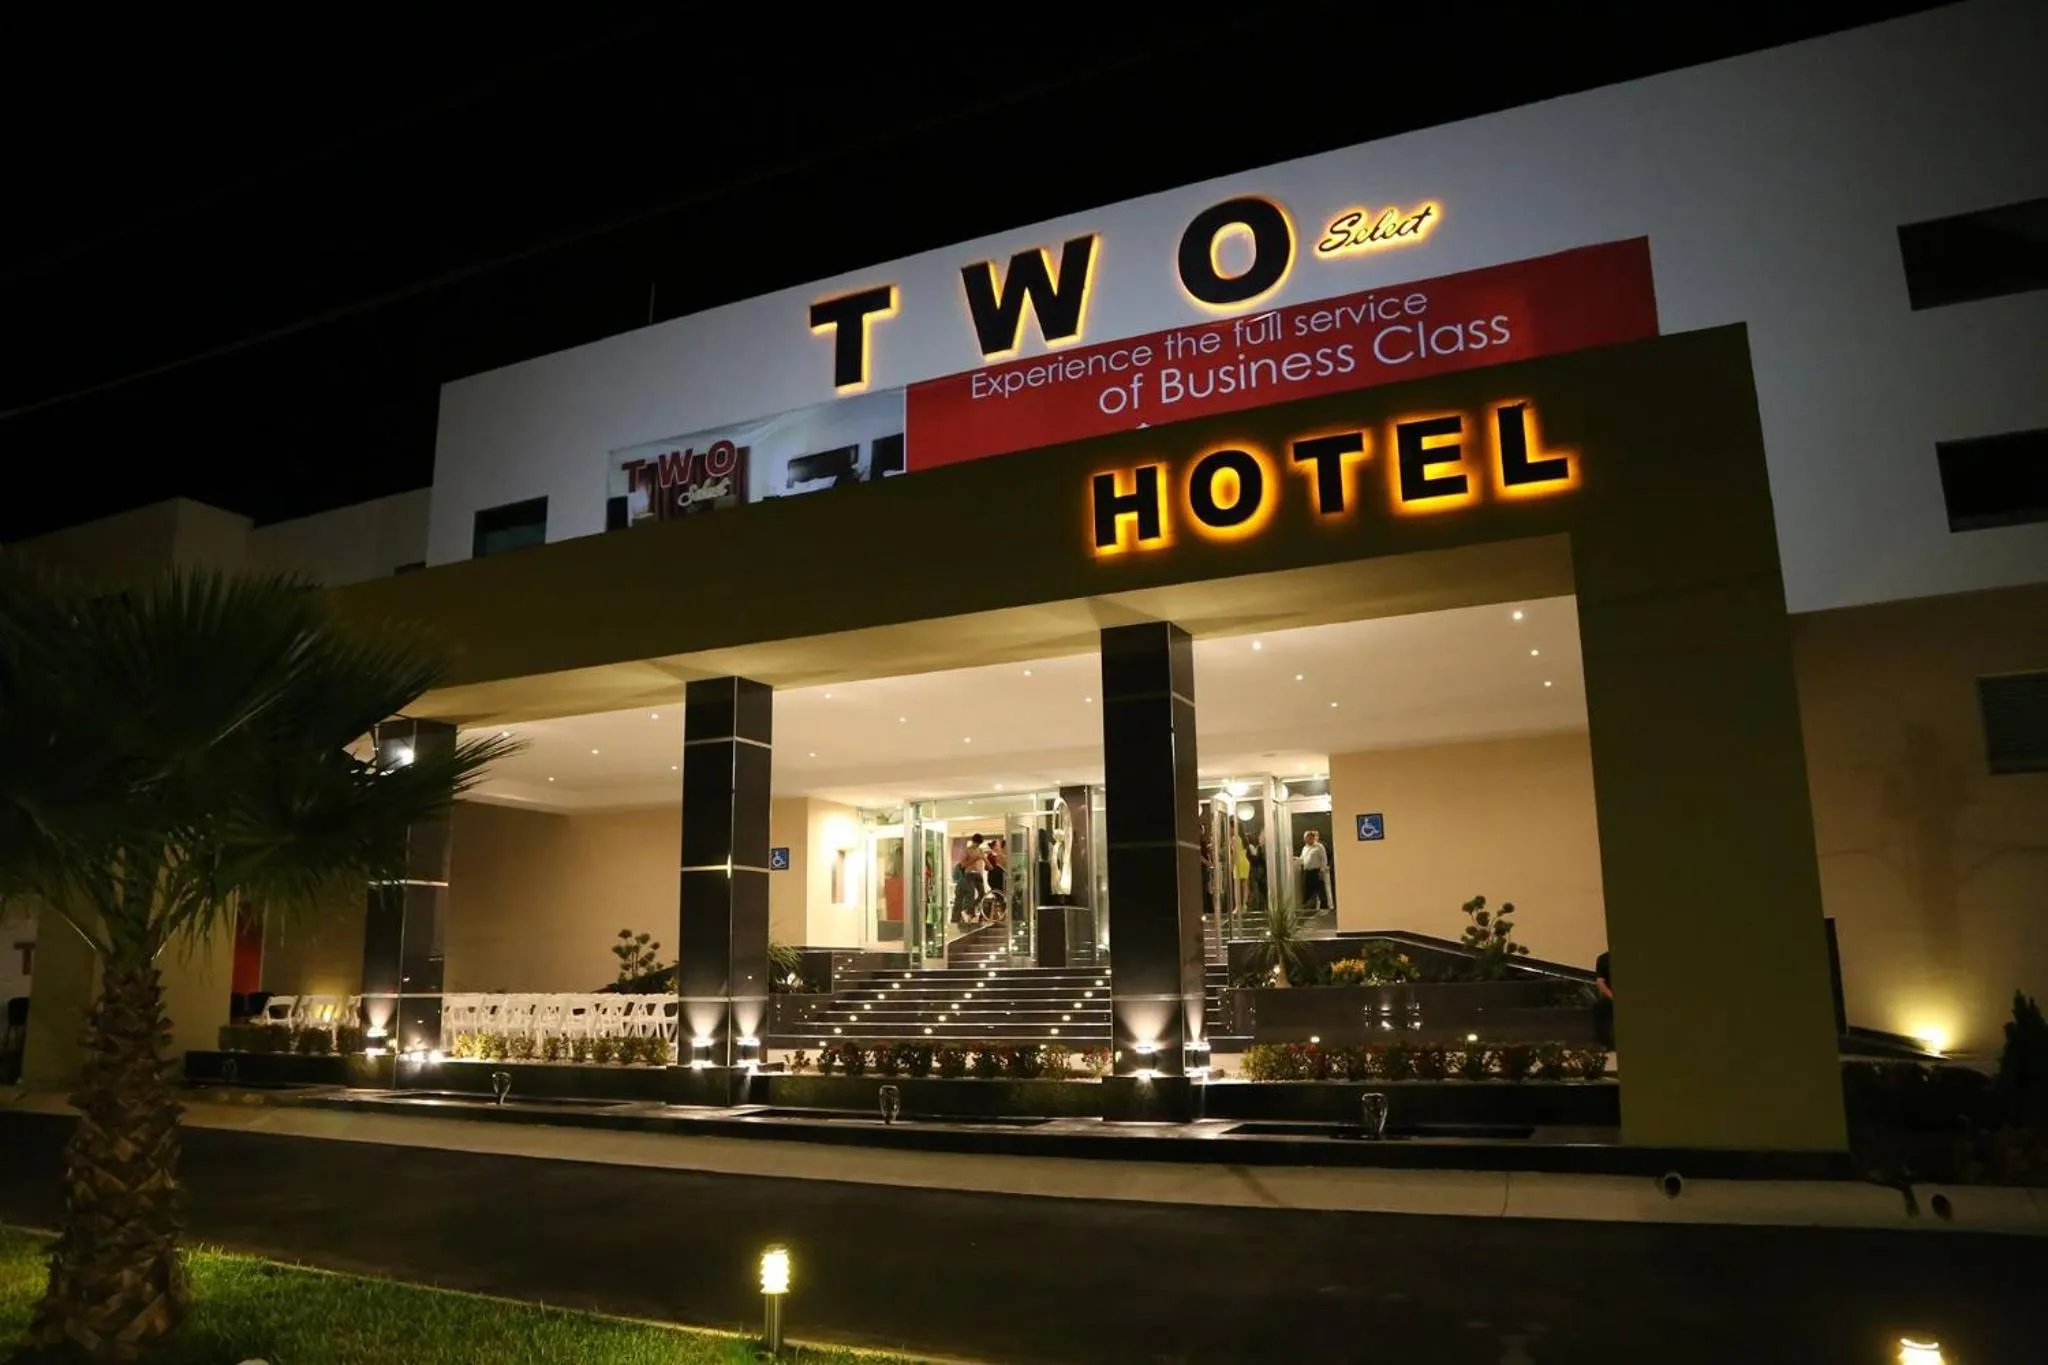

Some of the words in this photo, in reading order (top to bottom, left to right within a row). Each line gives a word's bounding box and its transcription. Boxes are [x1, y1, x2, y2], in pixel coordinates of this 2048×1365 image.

[810, 197, 1292, 389] TWO
[1318, 205, 1432, 252] Select
[971, 345, 1153, 399] Experience
[1164, 331, 1221, 361] the
[1233, 311, 1282, 347] full
[1294, 293, 1428, 337] service
[1099, 373, 1144, 415] of
[1160, 343, 1356, 405] Business
[1373, 314, 1511, 365] Class
[621, 440, 738, 493] TWO
[1092, 402, 1572, 549] HOTEL
